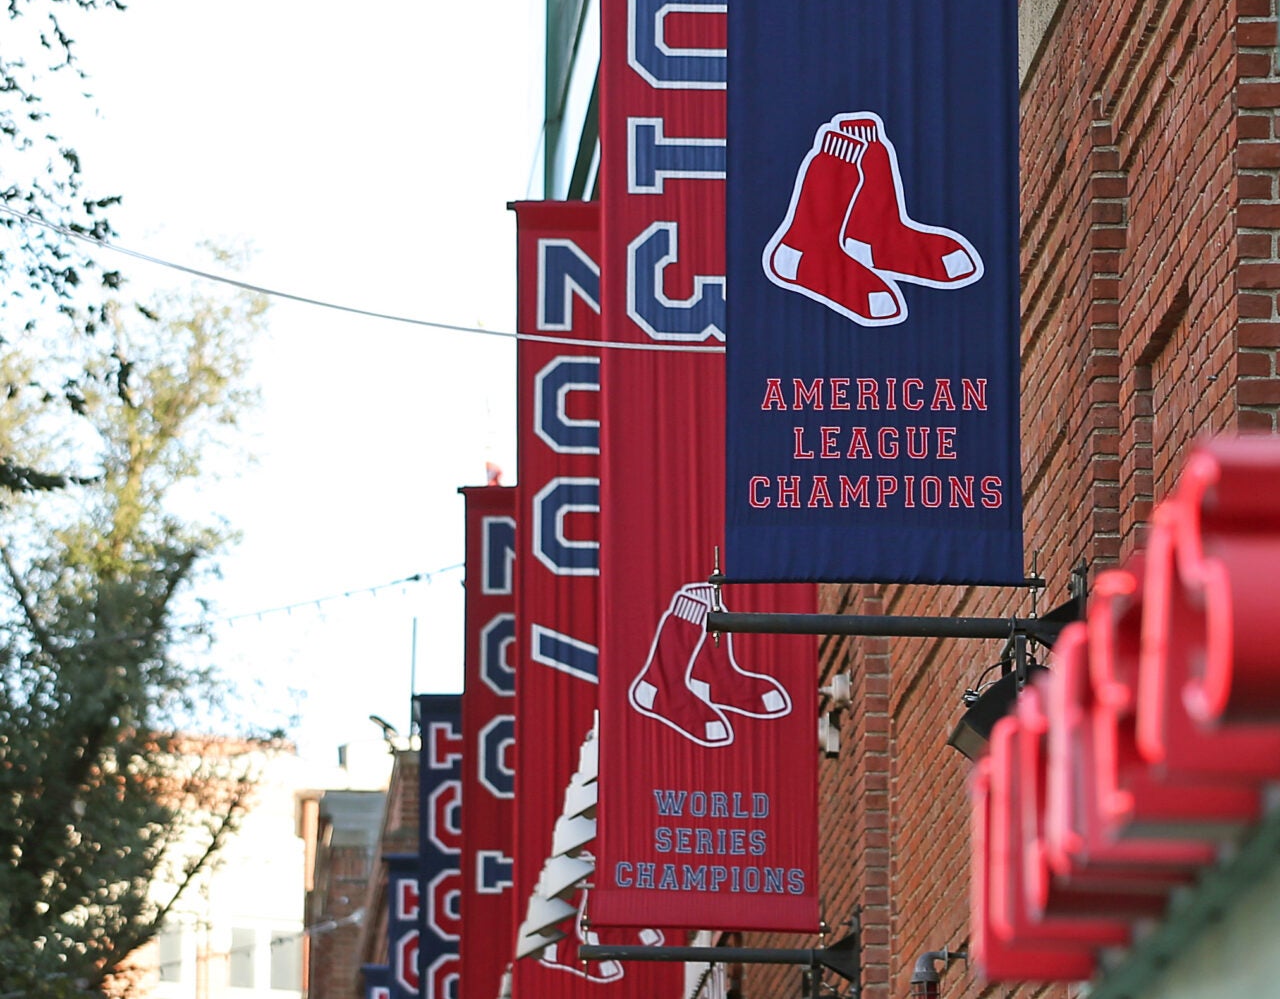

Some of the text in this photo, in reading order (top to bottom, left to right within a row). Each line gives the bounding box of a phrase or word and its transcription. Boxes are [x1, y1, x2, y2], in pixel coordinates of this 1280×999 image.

[761, 378, 988, 411] AMERICAN
[793, 426, 957, 460] LEAGUE
[748, 475, 1003, 509] CHAMPIONS
[653, 789, 770, 819] WORLD
[655, 827, 767, 855] SERIES
[615, 861, 805, 895] CHAMPIONS
